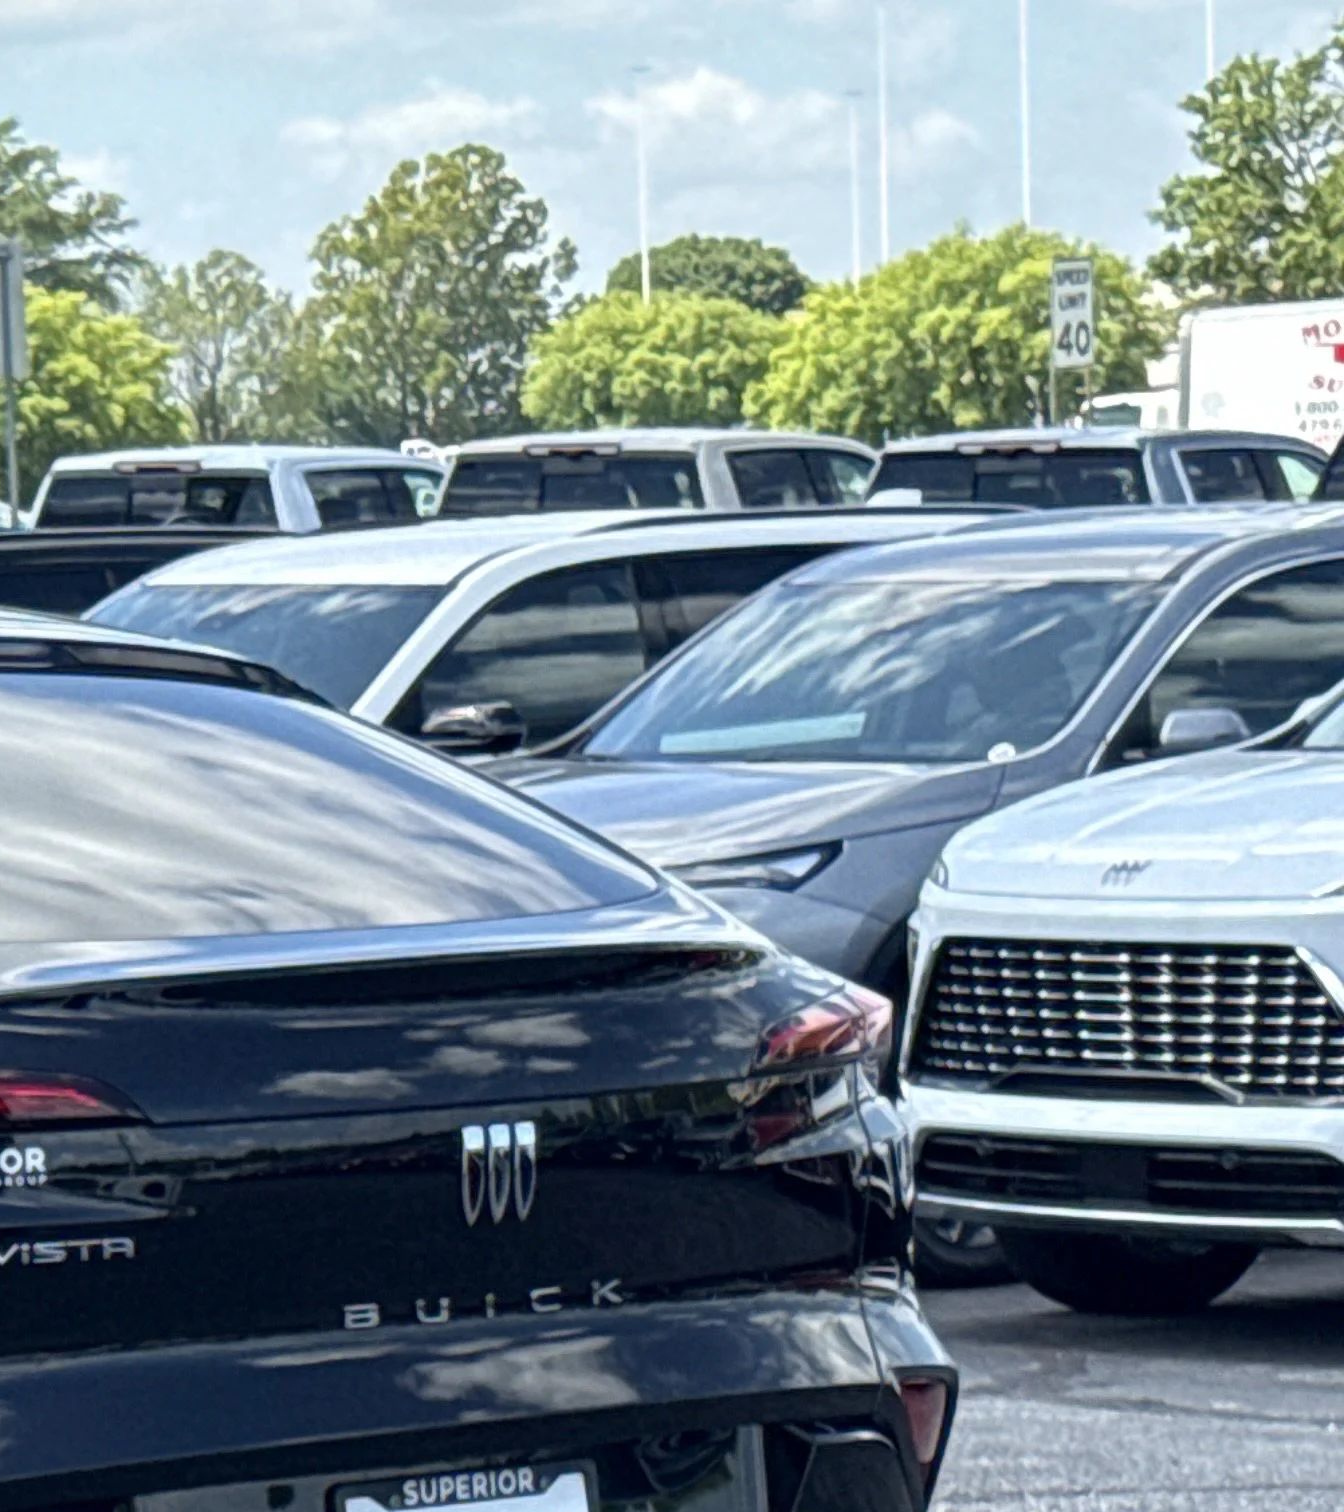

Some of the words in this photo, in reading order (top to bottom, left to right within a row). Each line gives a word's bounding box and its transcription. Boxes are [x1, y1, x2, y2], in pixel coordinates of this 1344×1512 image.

[1056, 319, 1091, 357] 40
[342, 1277, 624, 1330] BUICK
[402, 1466, 535, 1506] SUPERIOR
